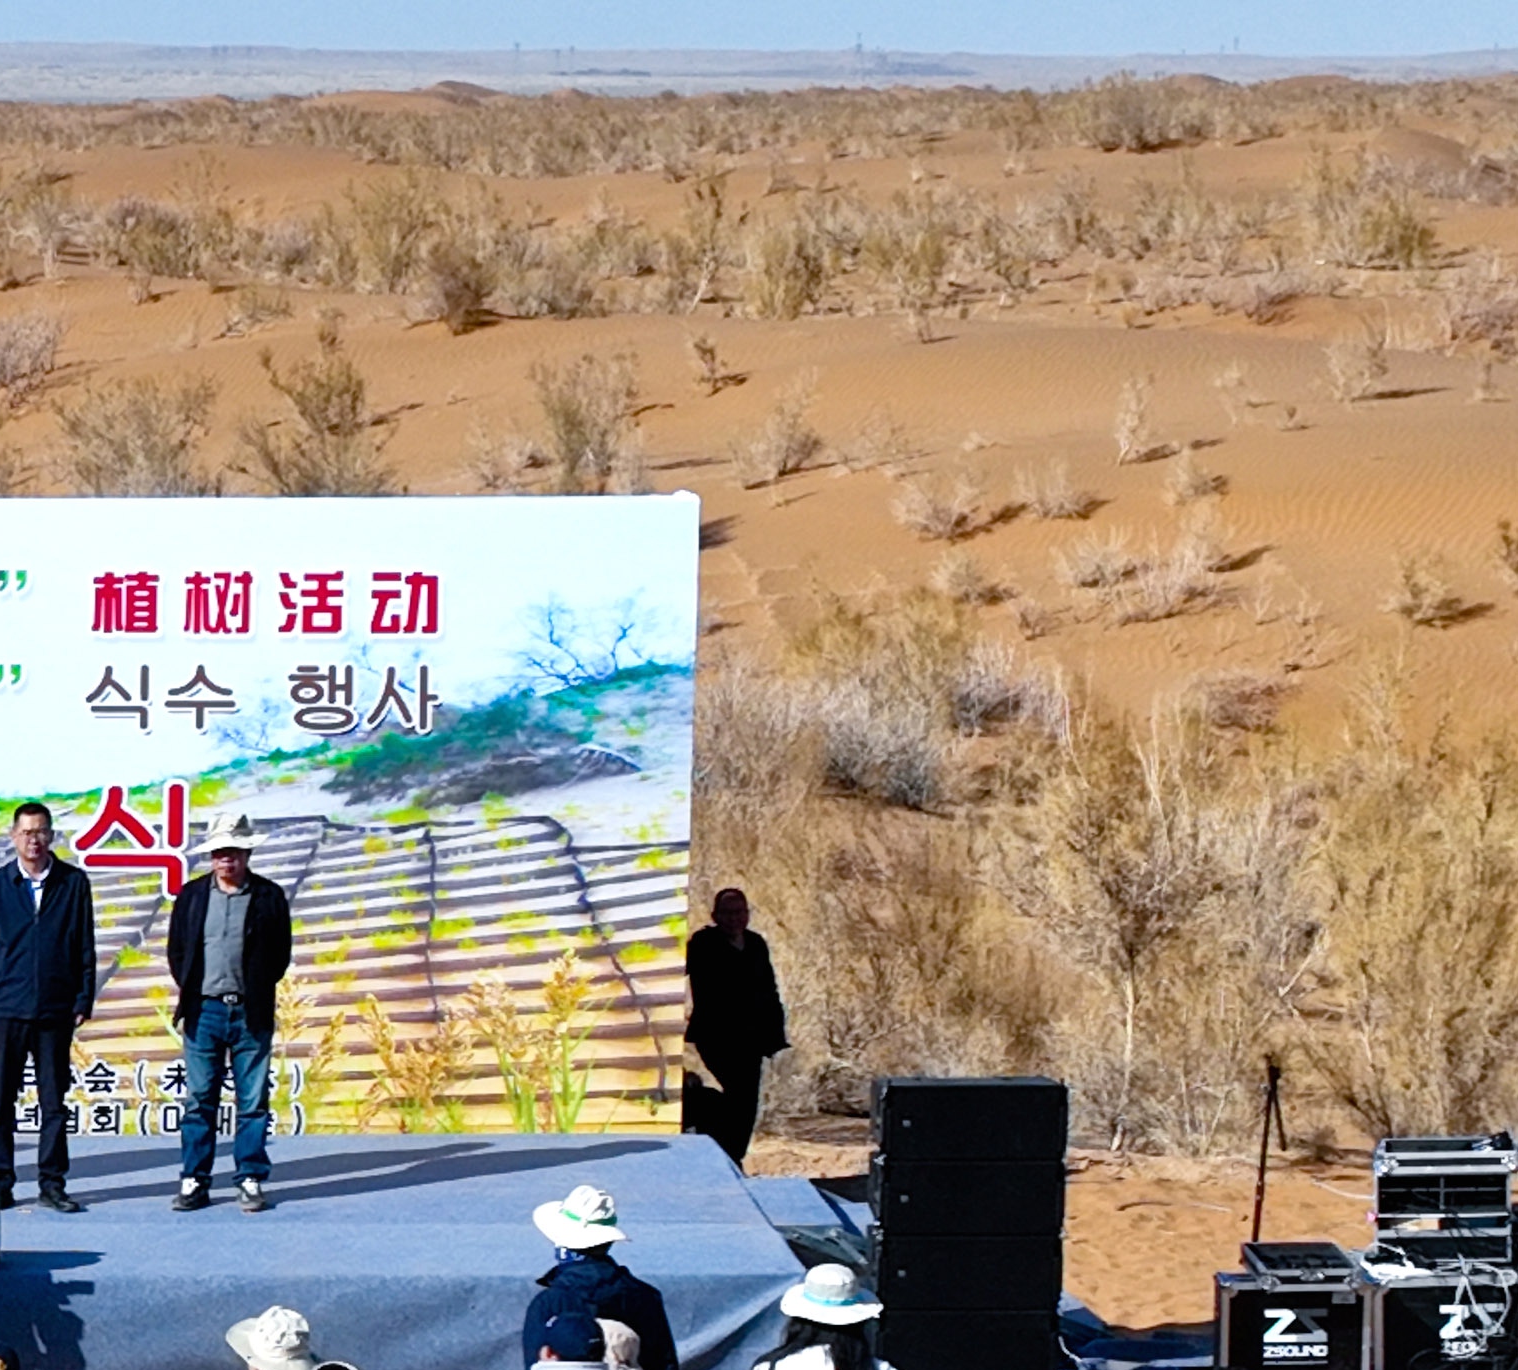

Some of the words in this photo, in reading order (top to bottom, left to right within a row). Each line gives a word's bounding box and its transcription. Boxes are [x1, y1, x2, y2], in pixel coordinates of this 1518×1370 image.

[91, 569, 440, 635] 植树活动
[84, 664, 238, 731] 식수
[287, 664, 441, 731] 행사
